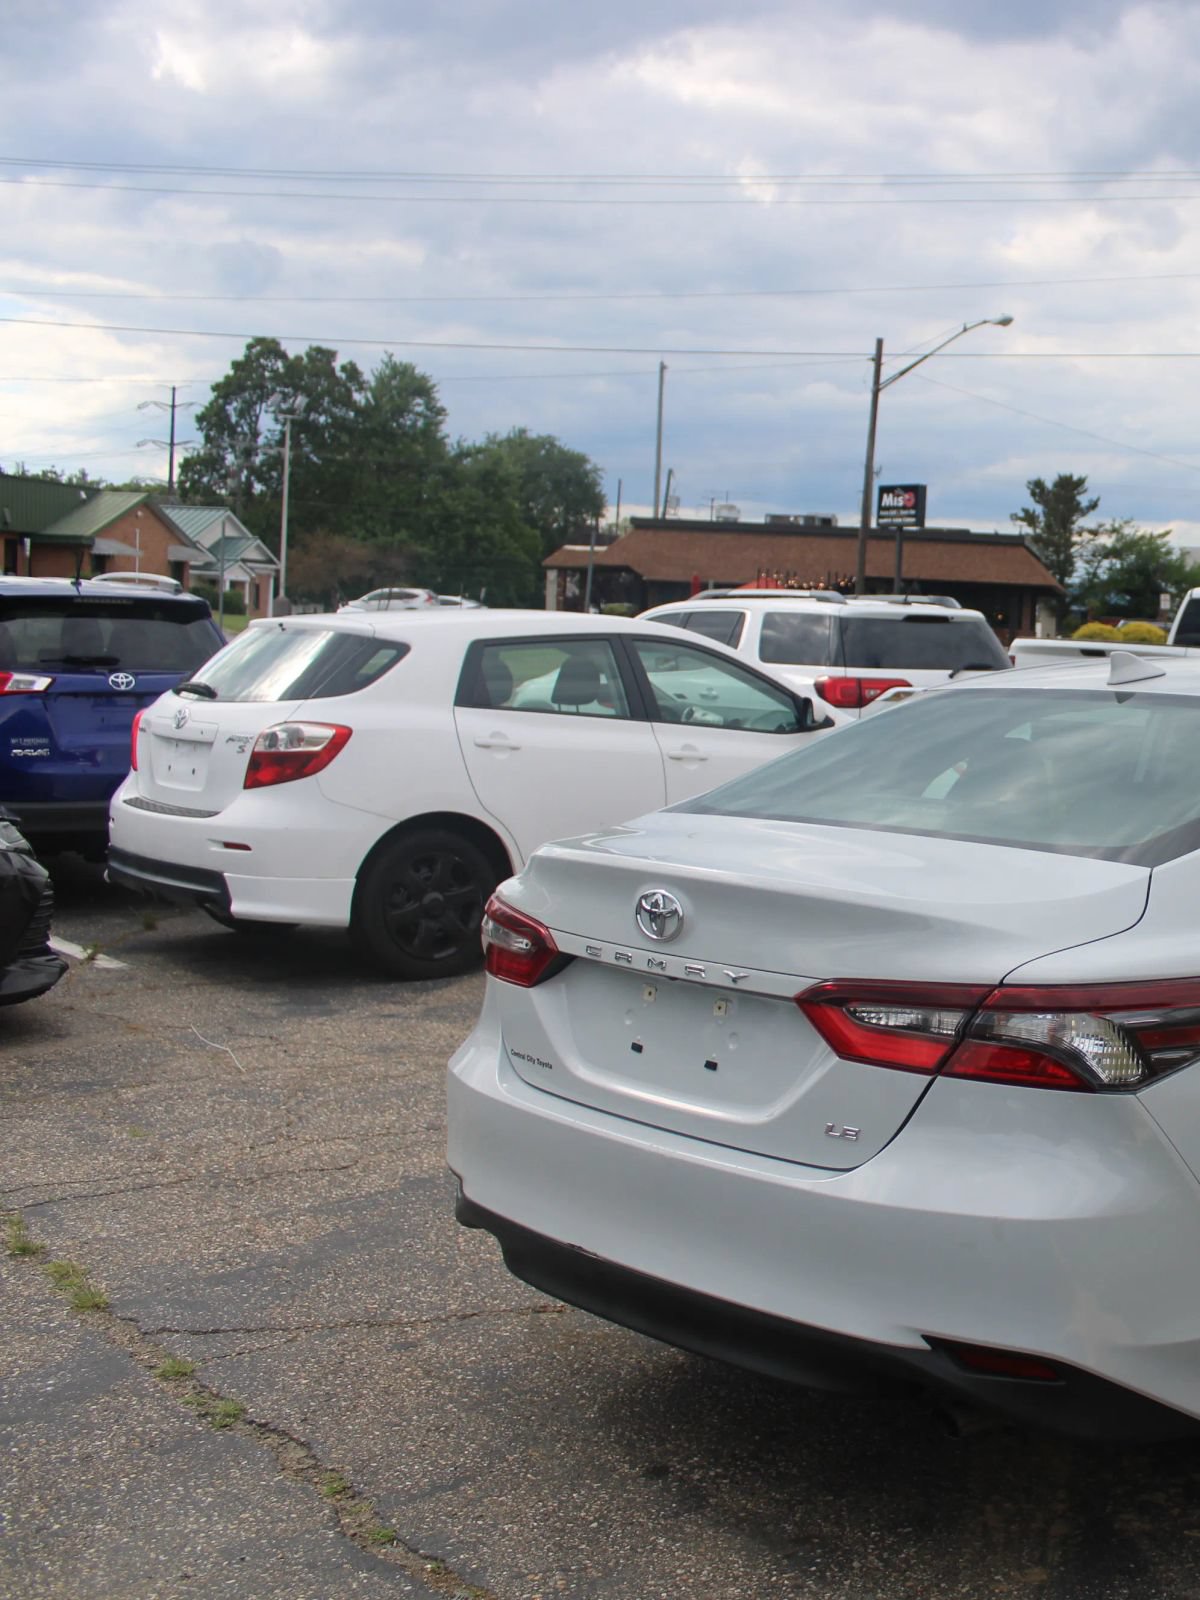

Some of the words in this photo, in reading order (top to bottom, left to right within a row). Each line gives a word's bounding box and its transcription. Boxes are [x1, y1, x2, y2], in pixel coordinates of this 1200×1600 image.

[585, 944, 752, 984] CAMRY
[527, 1054, 536, 1065] City
[536, 1057, 553, 1070] Toyota
[824, 1121, 861, 1141] LE
